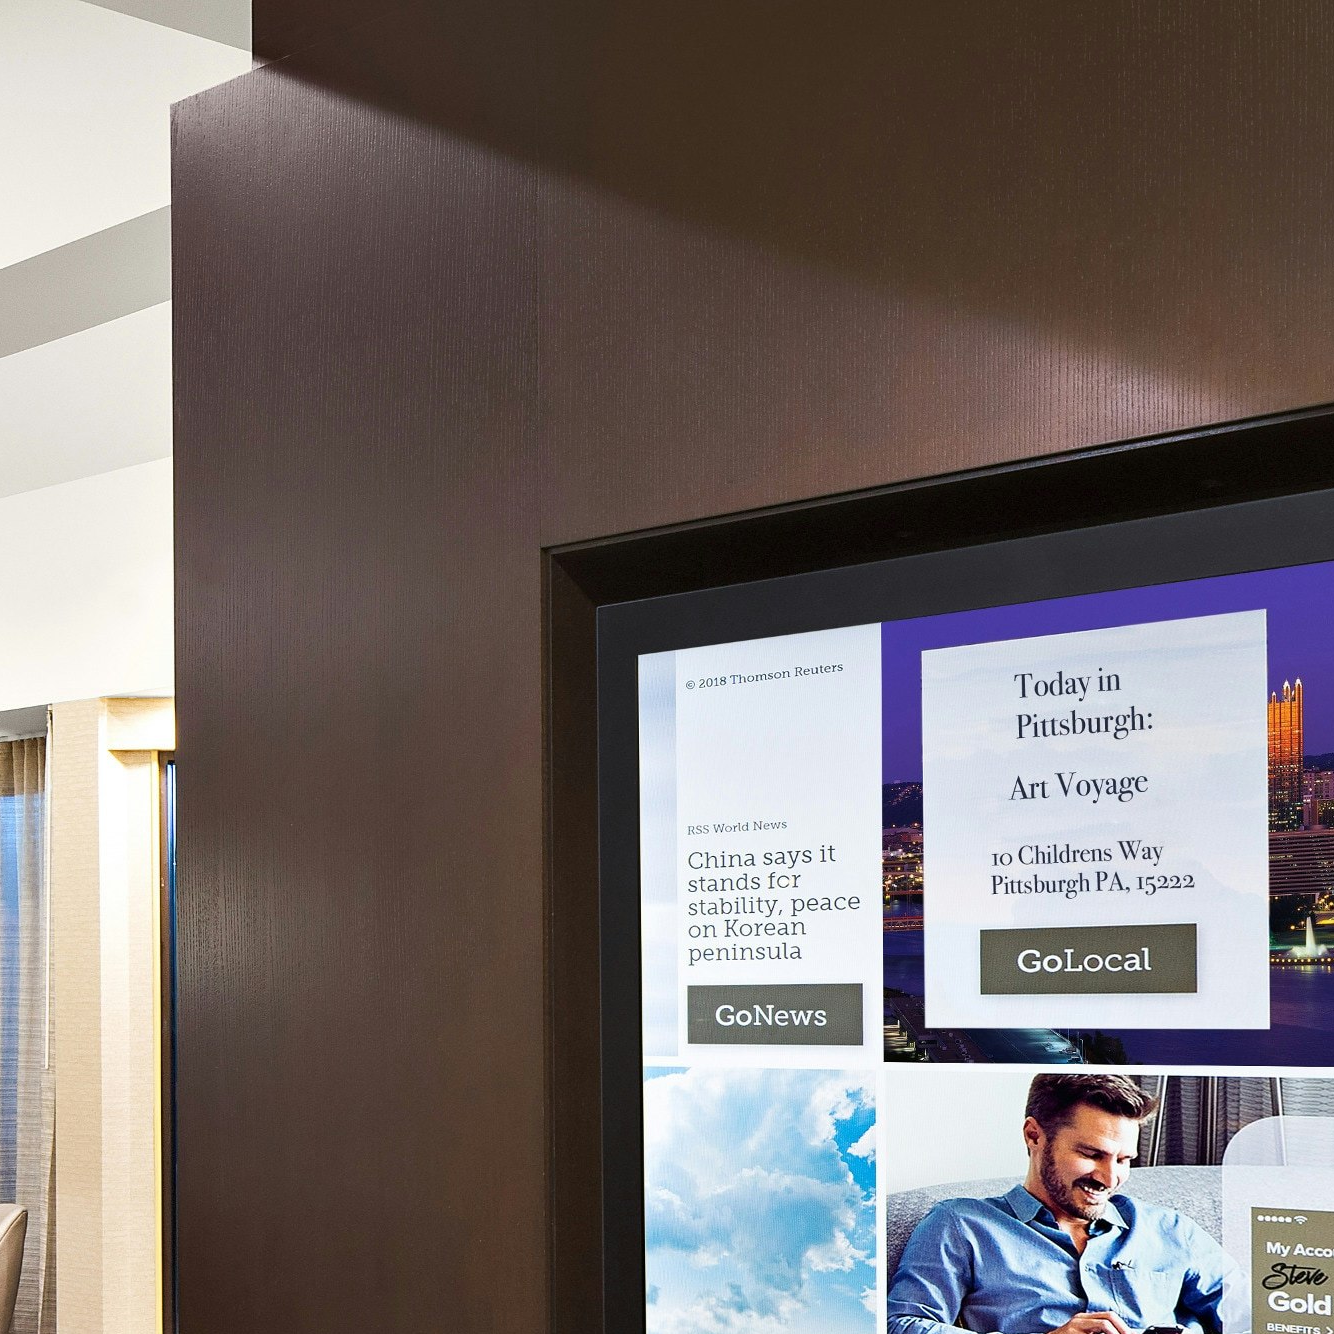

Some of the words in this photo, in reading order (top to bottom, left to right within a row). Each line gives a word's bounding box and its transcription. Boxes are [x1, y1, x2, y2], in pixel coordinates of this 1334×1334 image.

[699, 677, 726, 688] 2018
[730, 669, 790, 684] Thomson
[795, 664, 844, 677] Reuters
[1014, 670, 1090, 701] Today
[1098, 668, 1121, 692] in
[1016, 706, 1153, 740] Pittsburgh:
[1009, 775, 1050, 800] Art
[1055, 771, 1149, 804] Voyage
[688, 825, 709, 835] RSS
[714, 822, 749, 833] World
[753, 820, 787, 830] News
[688, 851, 756, 869] China
[763, 850, 812, 868] says
[819, 845, 836, 862] it
[991, 851, 1013, 867] 10
[1018, 844, 1112, 865] Childrens
[1118, 839, 1164, 866] Way
[688, 874, 760, 892] stands
[768, 872, 801, 889] for
[991, 872, 1090, 899] Pittsburgh
[1096, 870, 1130, 894] PA,
[1136, 874, 1195, 895] 15222
[688, 897, 783, 917] stability,
[791, 895, 860, 916] peace
[688, 924, 717, 938] on
[724, 919, 806, 937] Korean
[689, 943, 802, 966] peninsula
[1017, 948, 1152, 973] GoLocal
[715, 1004, 827, 1026] GoNews
[1267, 1242, 1290, 1257] My
[1262, 1263, 1328, 1290] Steve
[1267, 1290, 1331, 1316] Gold
[1267, 1323, 1320, 1334] BENEFITS
